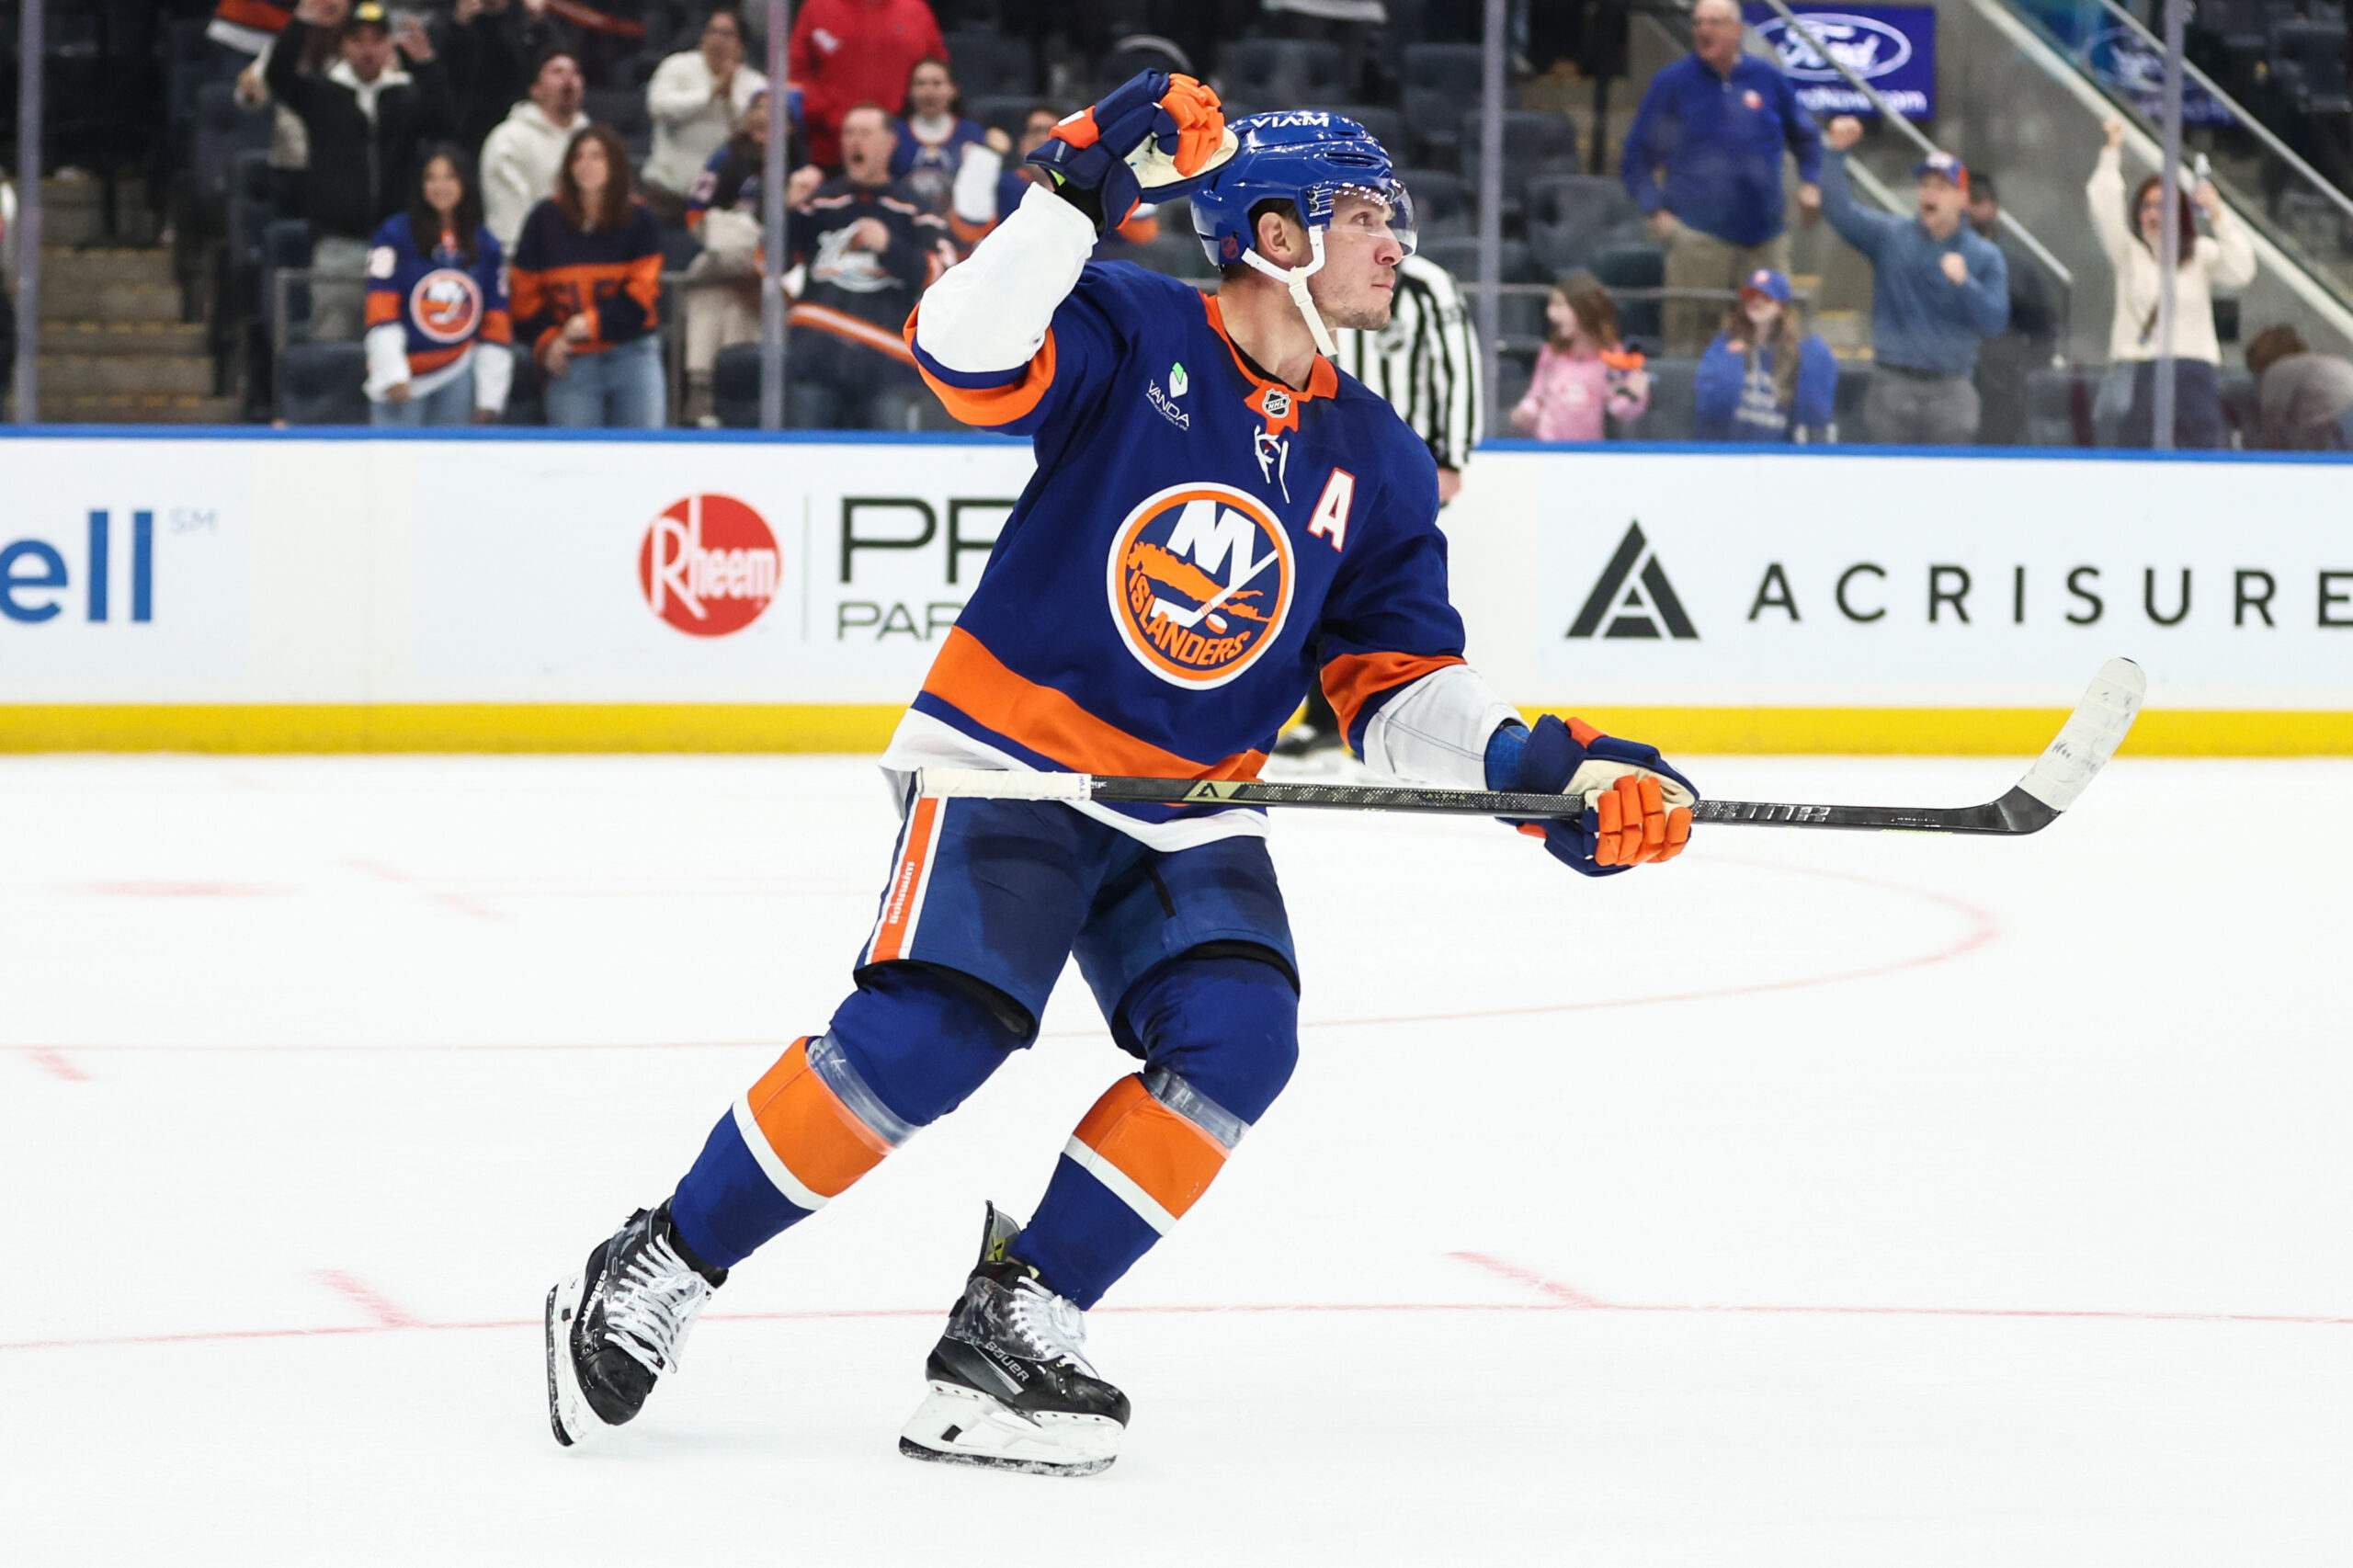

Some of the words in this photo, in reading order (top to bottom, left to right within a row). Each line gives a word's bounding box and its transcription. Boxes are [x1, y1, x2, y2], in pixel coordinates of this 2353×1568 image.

[1250, 116, 1330, 129] VIAM
[1148, 379, 1189, 427] VANDA
[1307, 467, 1356, 552] A
[0, 509, 153, 624] ell
[650, 496, 776, 621] Rheem
[1747, 562, 2353, 628] ACRISURE
[1129, 573, 1251, 665] ISLANDERS
